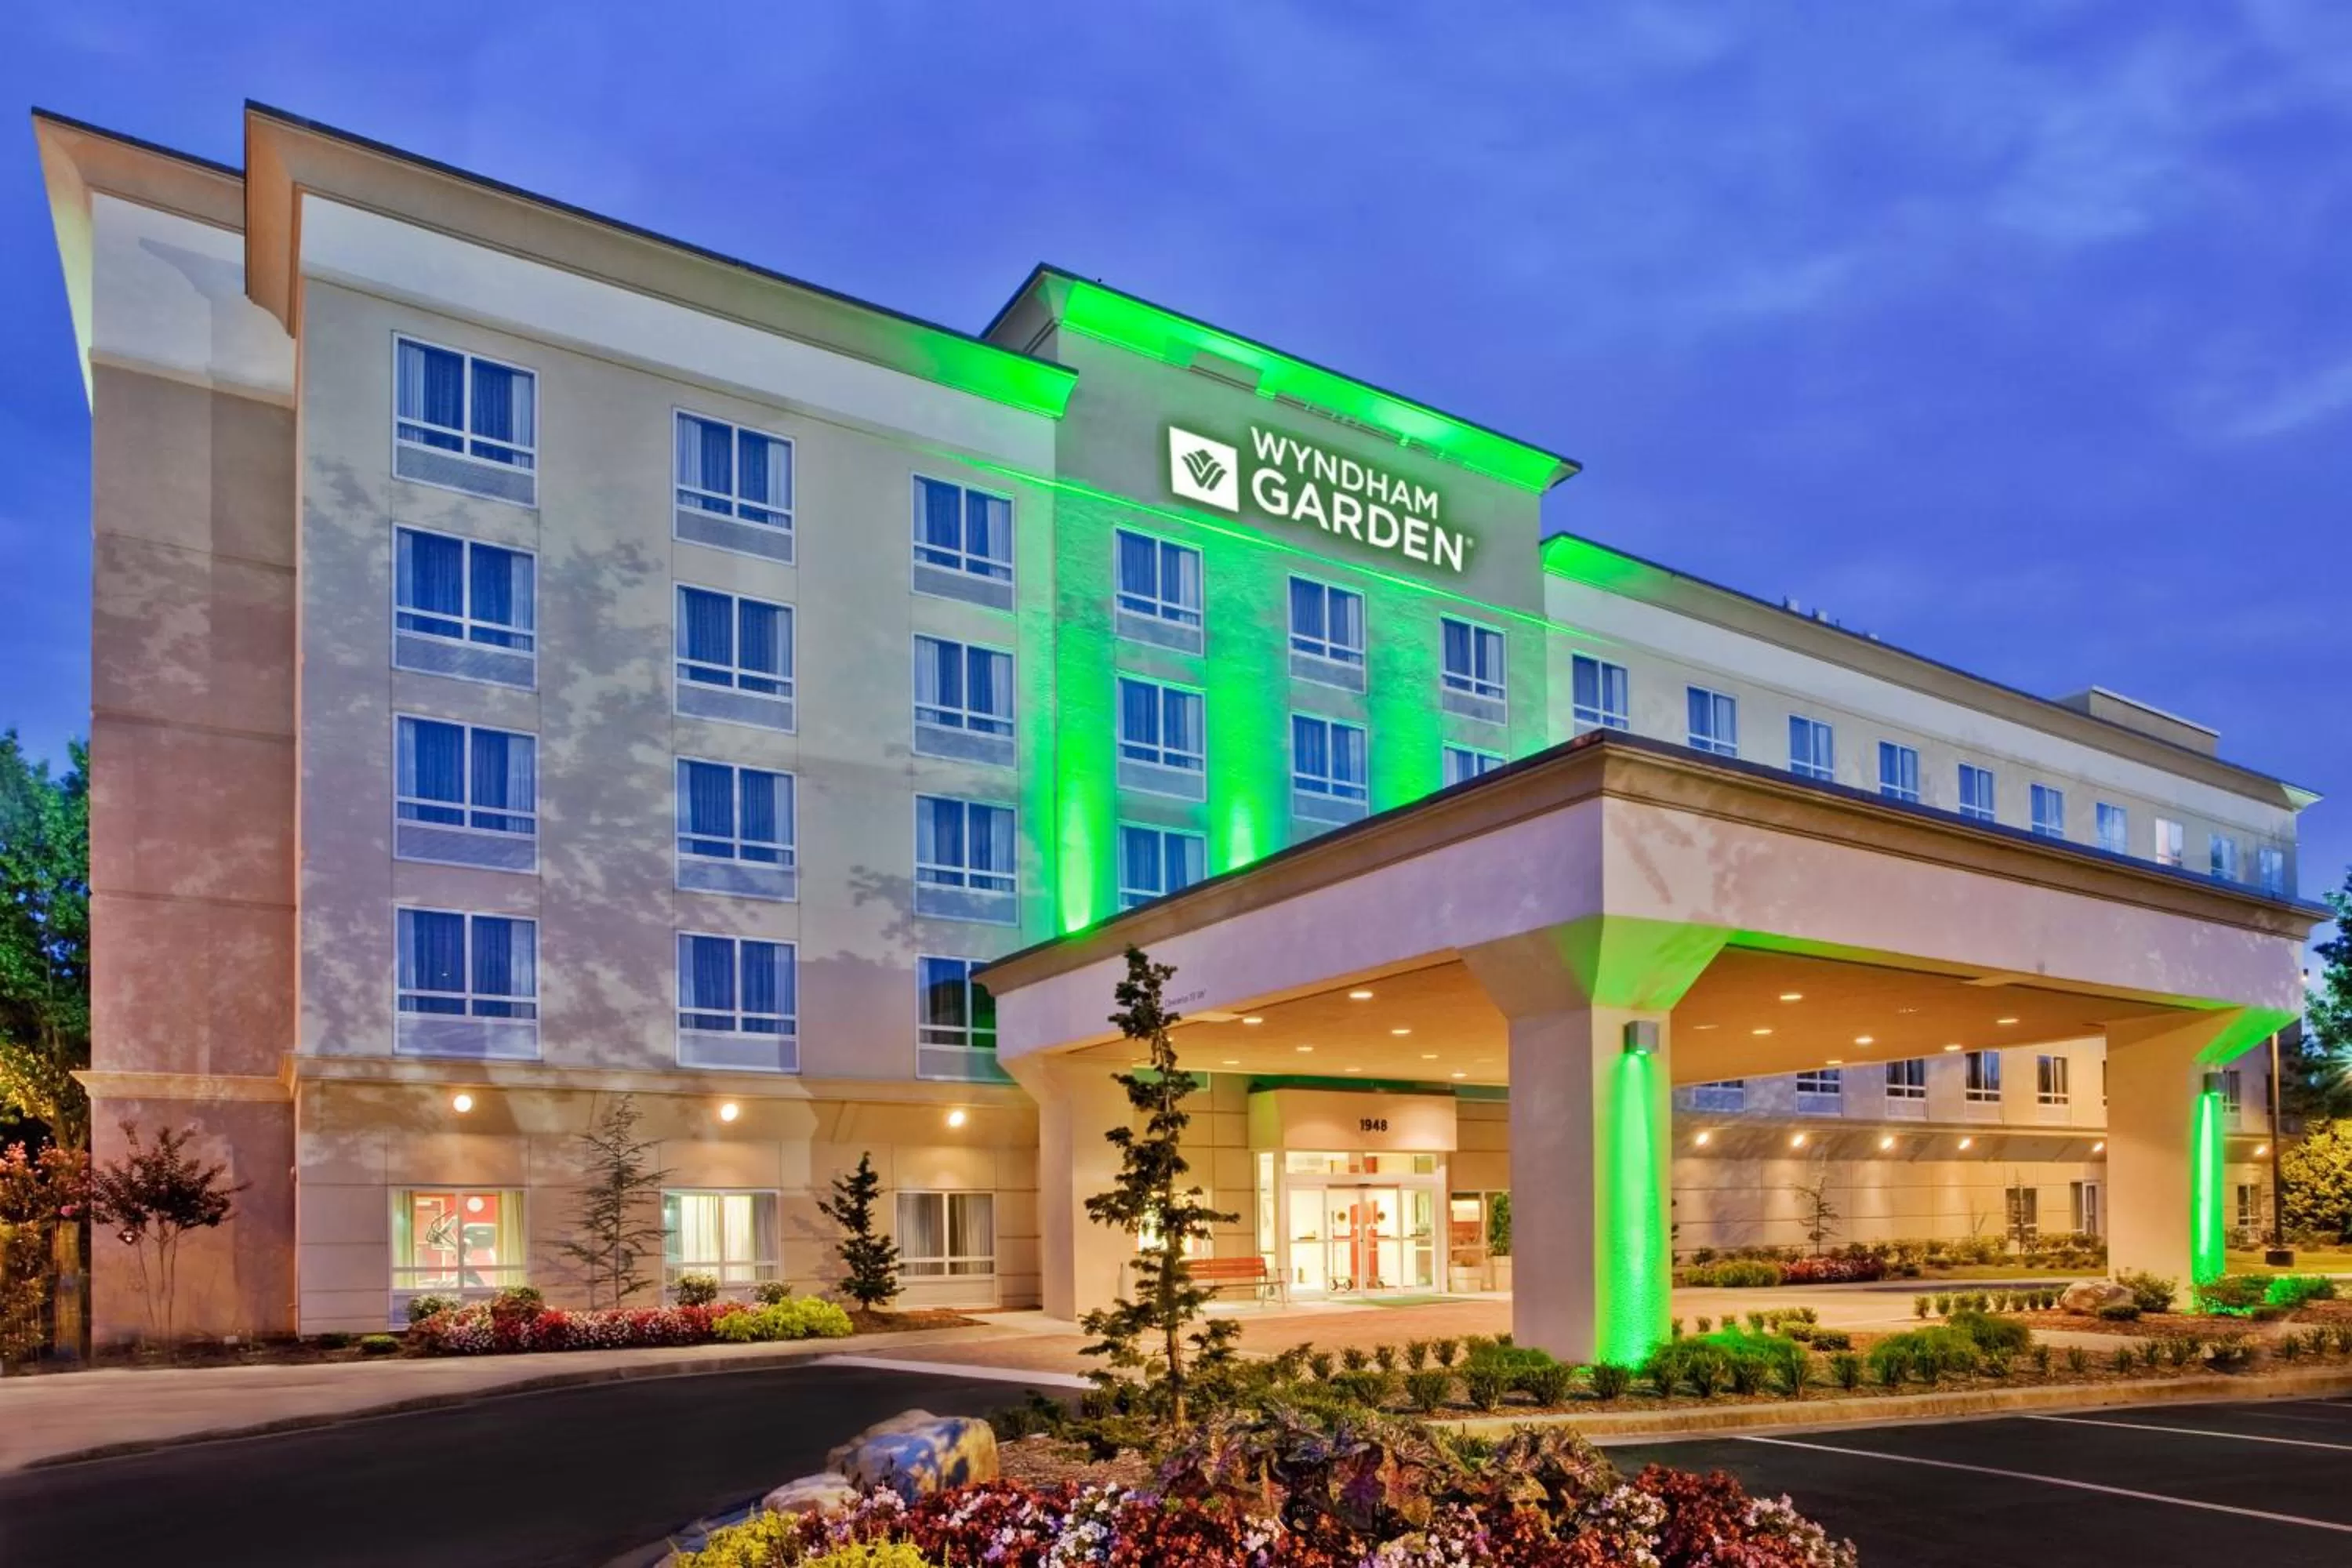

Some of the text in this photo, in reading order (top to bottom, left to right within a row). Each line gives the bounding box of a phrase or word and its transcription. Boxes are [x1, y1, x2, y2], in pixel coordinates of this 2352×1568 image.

[1250, 426, 1439, 519] WYNDHAM
[1252, 468, 1464, 572] GARDEN
[1359, 1119, 1388, 1131] 1948
